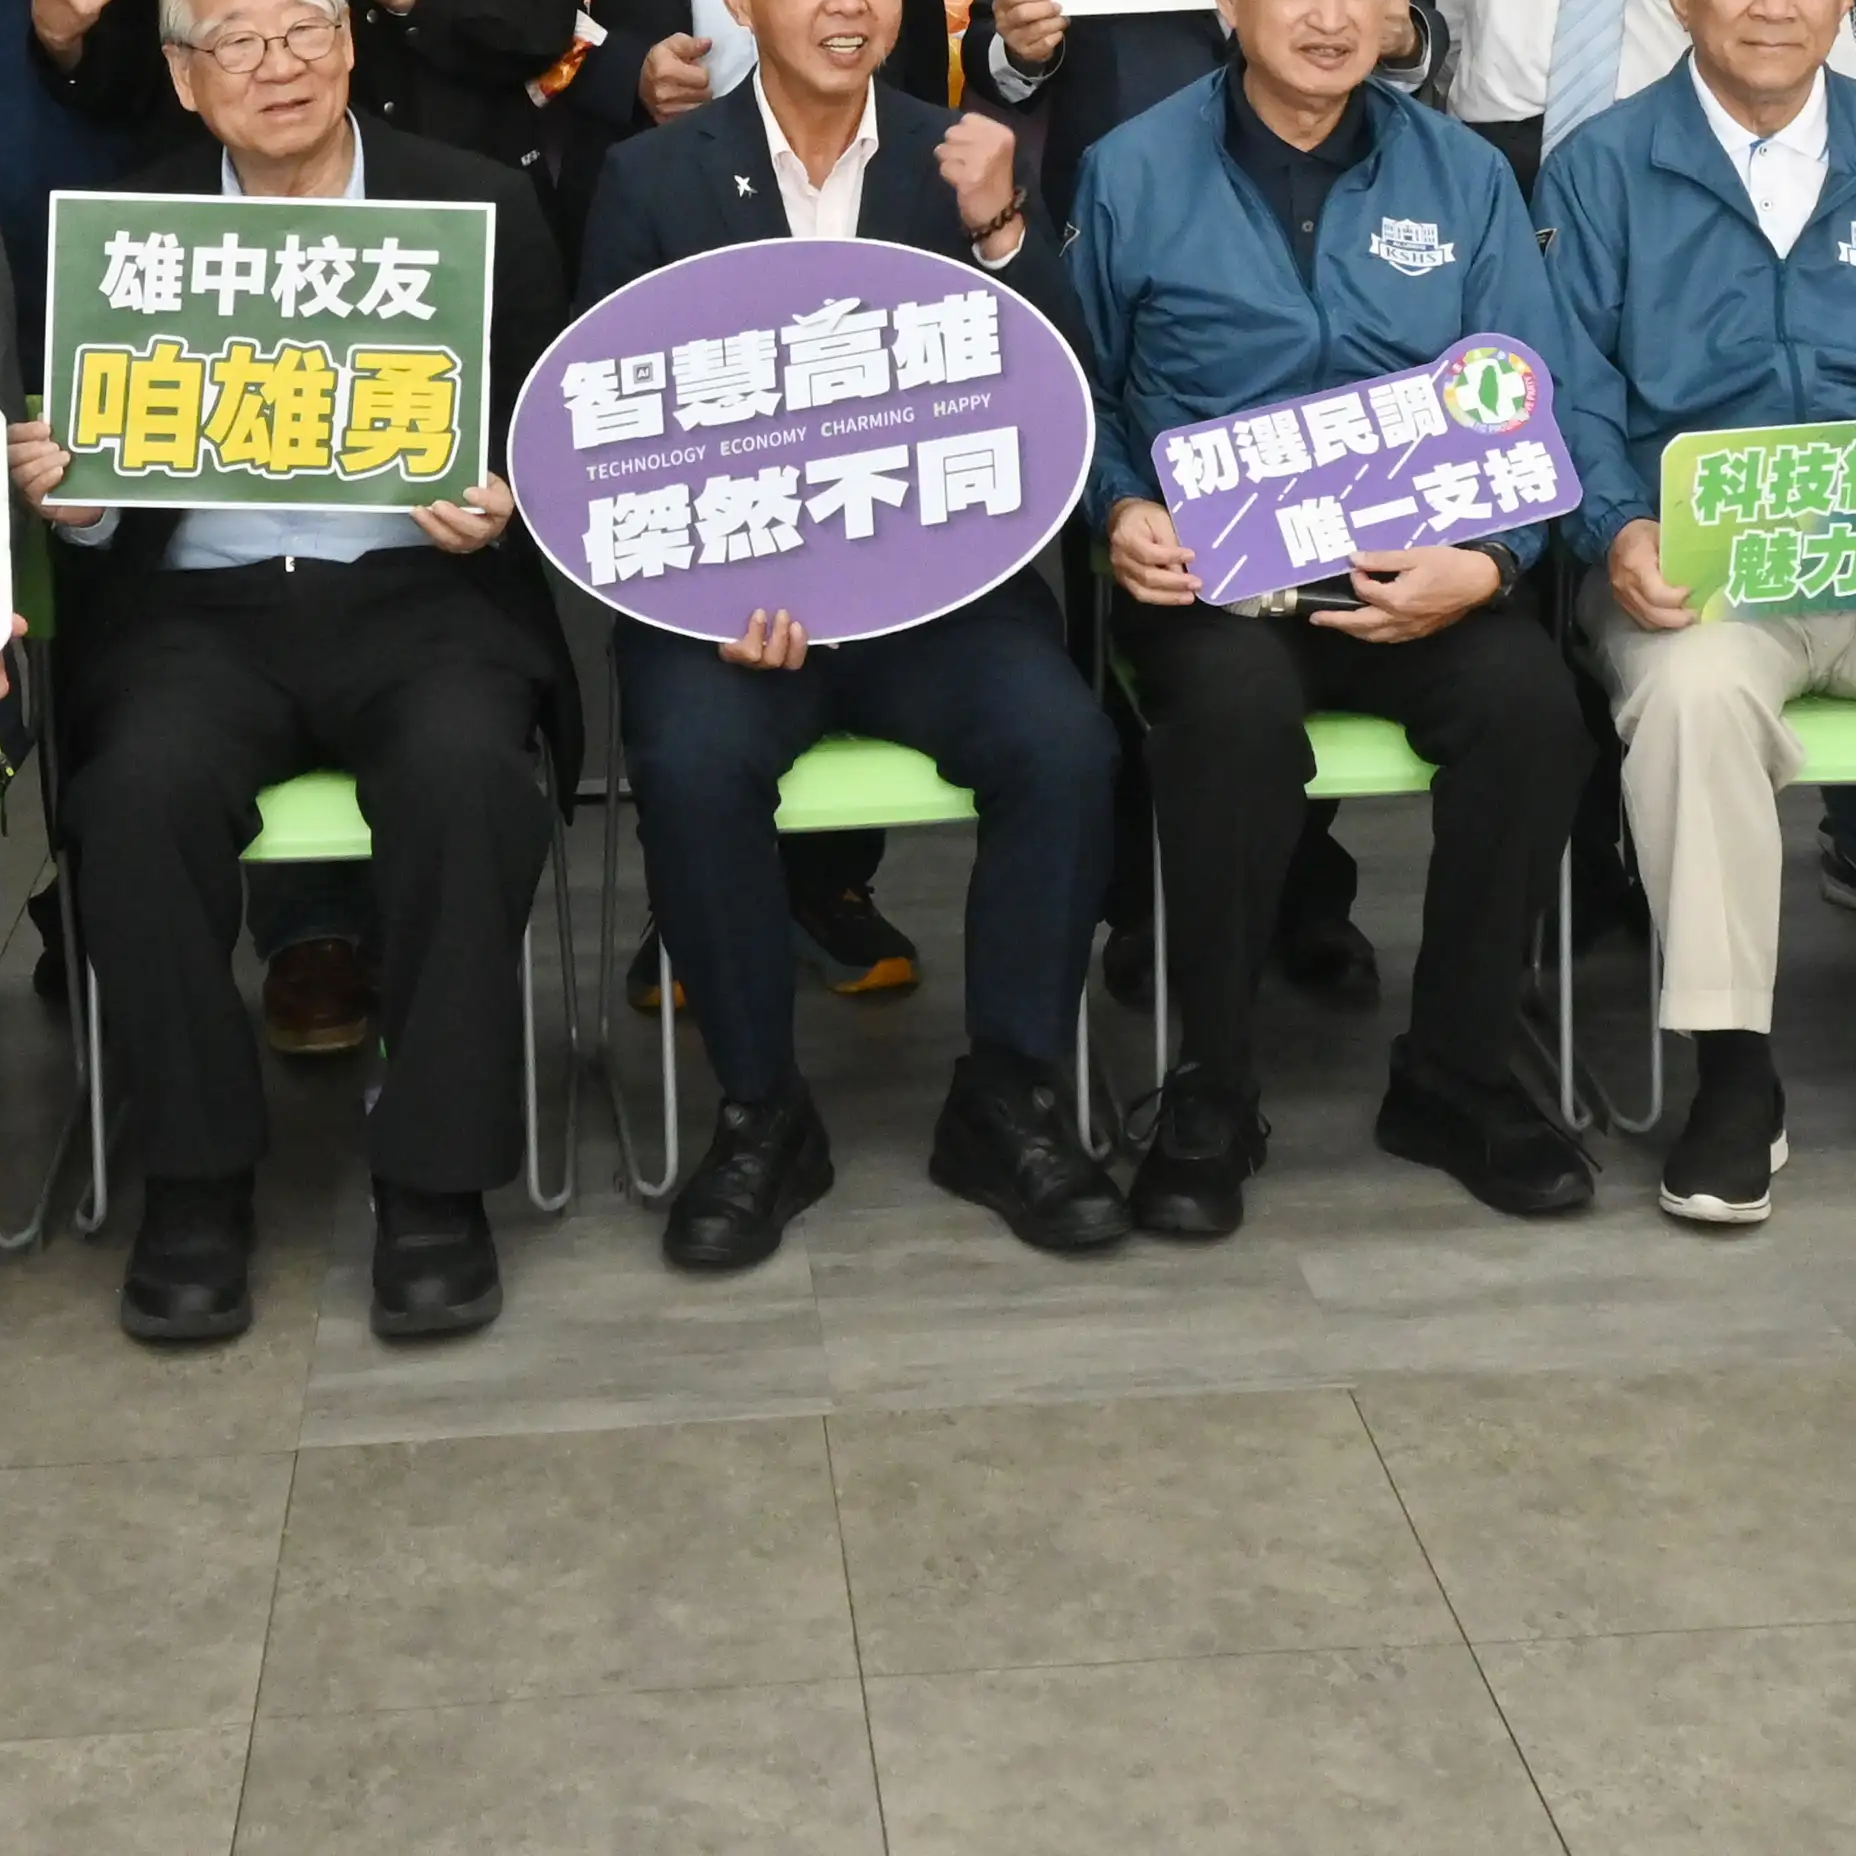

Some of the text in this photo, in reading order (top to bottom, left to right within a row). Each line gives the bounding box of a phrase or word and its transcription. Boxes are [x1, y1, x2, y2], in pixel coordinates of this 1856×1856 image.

[99, 230, 440, 320] 雄中校友
[1386, 246, 1437, 264] KSHS
[76, 342, 456, 476] 咱雄勇
[559, 290, 1003, 450] 智慧高雄
[586, 392, 992, 482] TECHNOLOGY ECONOMY CHARMING HAPPY
[1166, 373, 1449, 501] 初選民調
[582, 424, 1023, 587] 傑然不同
[1275, 440, 1558, 569] 唯一支持
